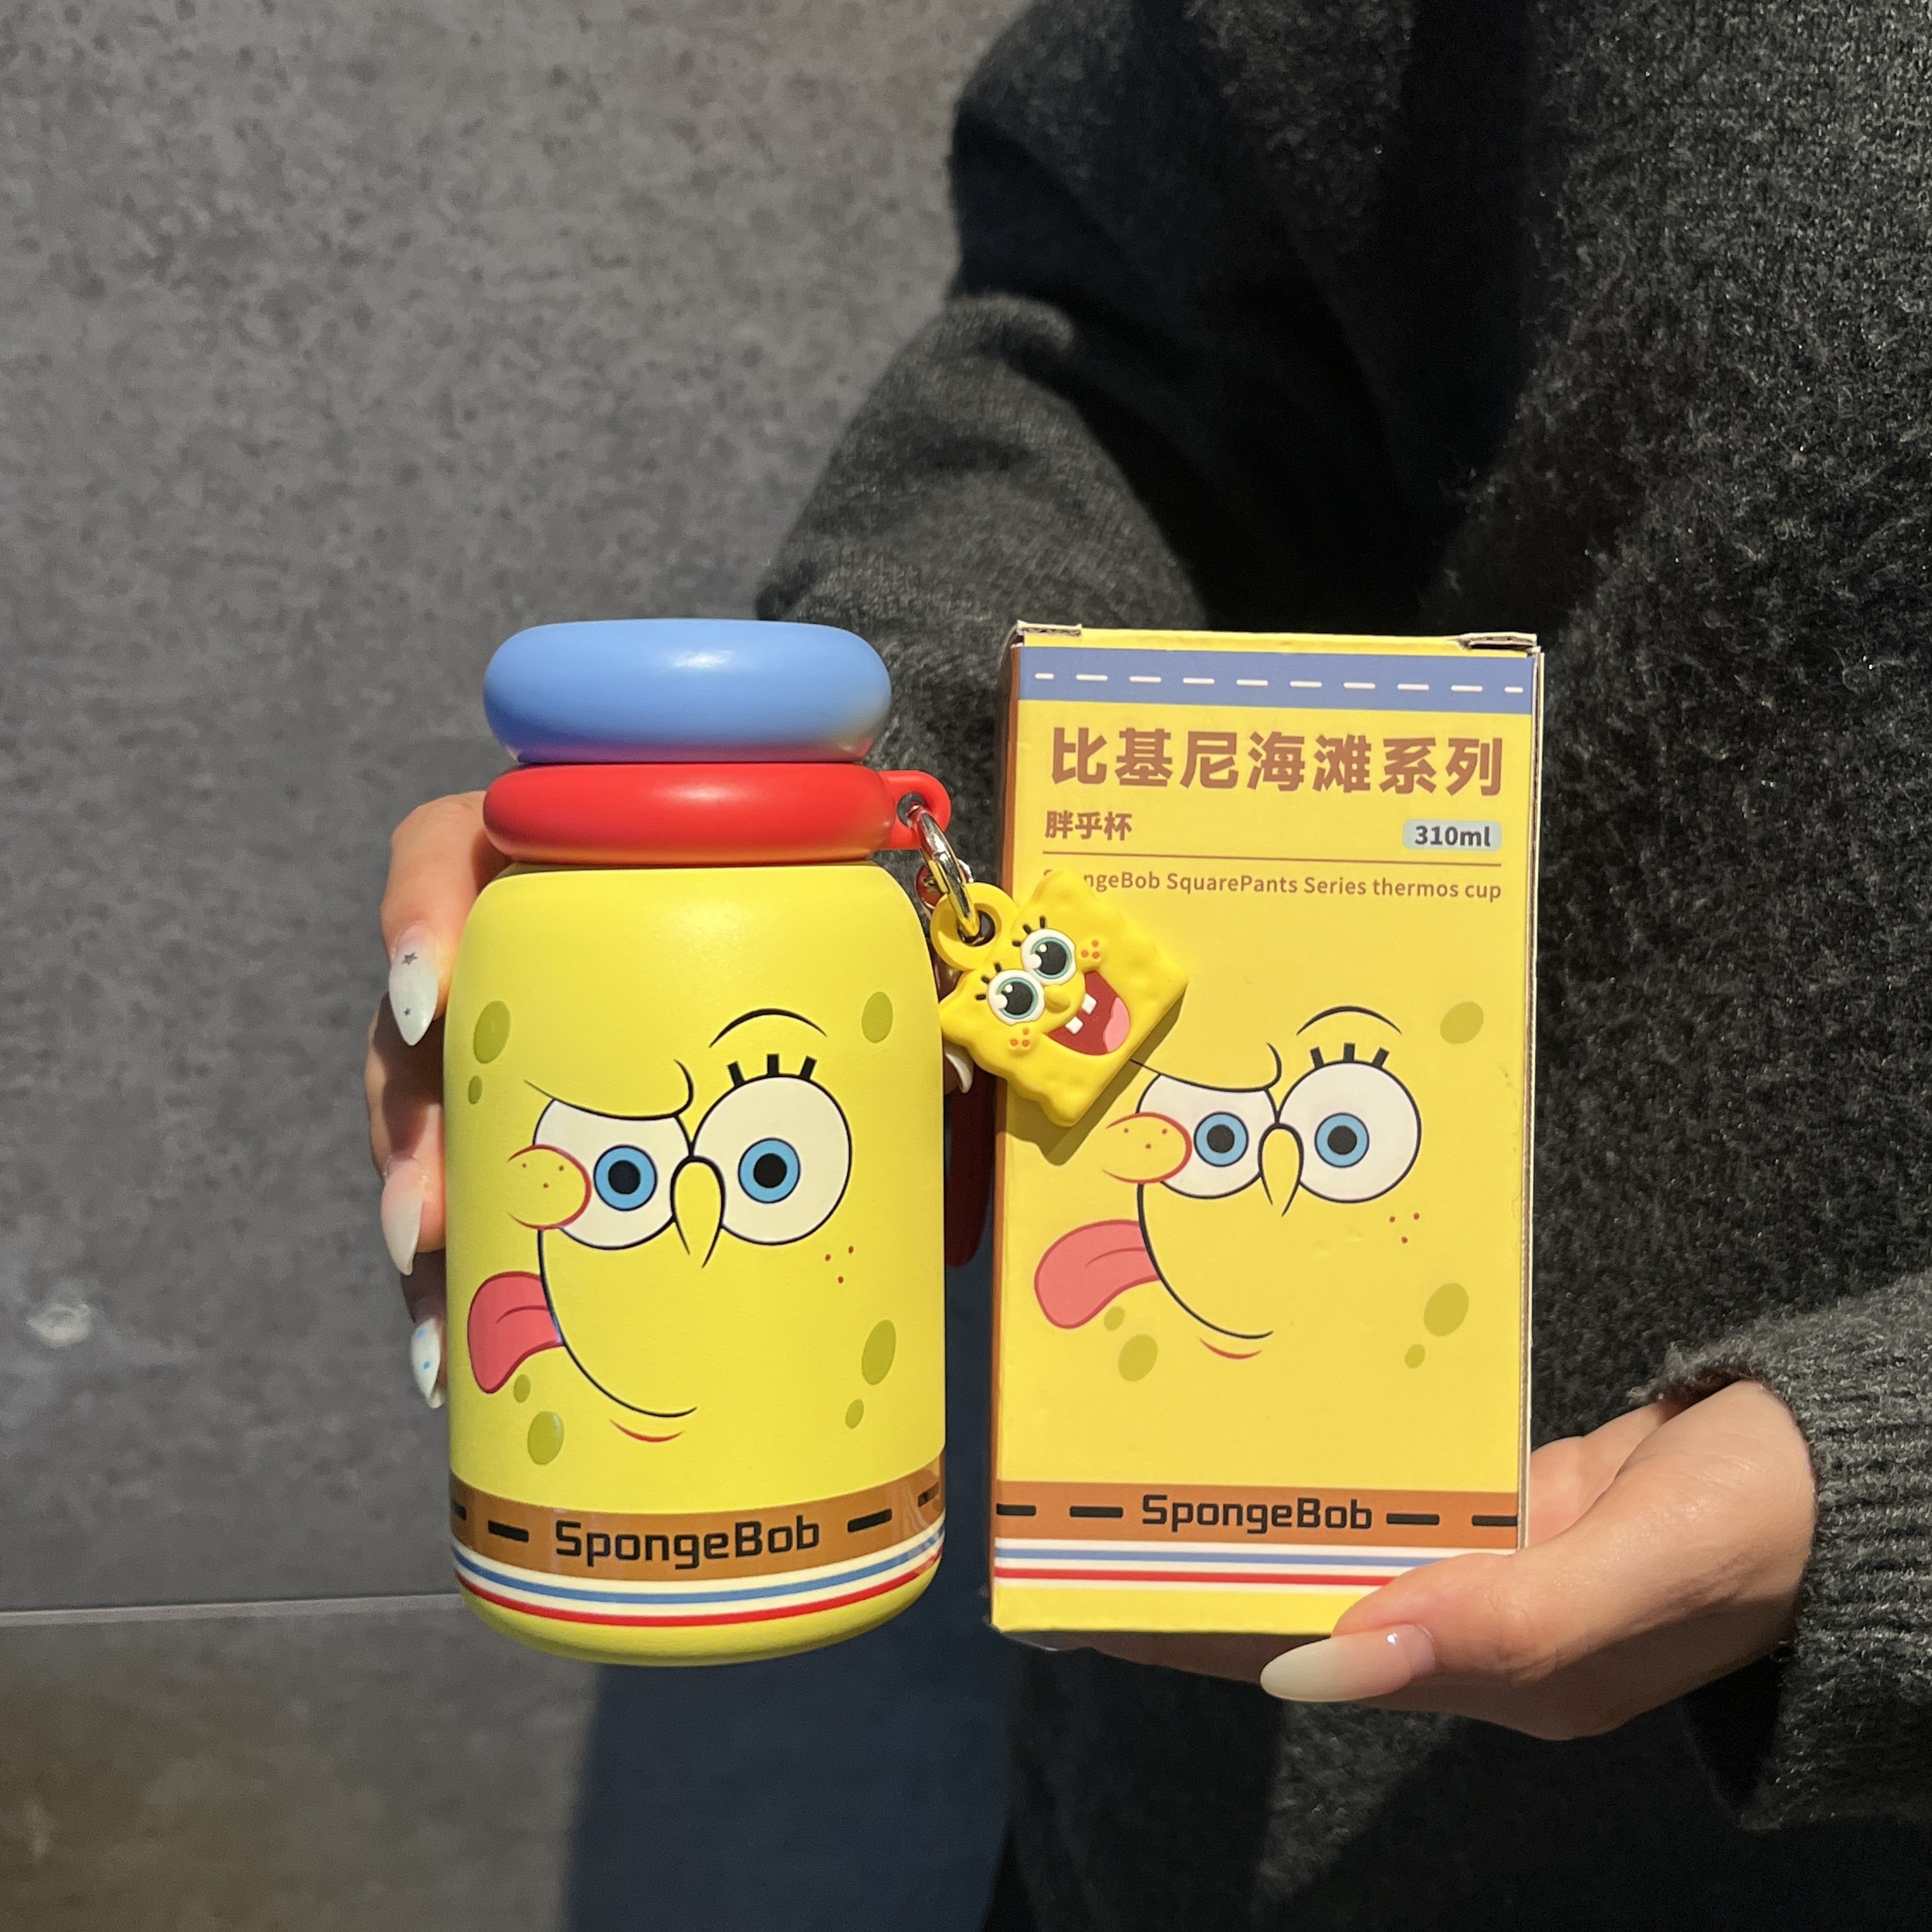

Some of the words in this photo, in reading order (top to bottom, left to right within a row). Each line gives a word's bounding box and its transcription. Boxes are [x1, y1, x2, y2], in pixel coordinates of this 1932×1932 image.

[1052, 727, 1503, 795] 比基尼海滩系列
[1045, 810, 1133, 841] 胖乎杯
[1414, 825, 1491, 847] 310ml
[1044, 870, 1161, 892] ngeBob
[1167, 873, 1298, 894] SquarePants
[1304, 877, 1367, 896] Series
[1373, 878, 1459, 898] thermos
[1465, 883, 1502, 902] cup
[1142, 1494, 1372, 1534] SpongeBob
[555, 1515, 820, 1569] SpongeBob
